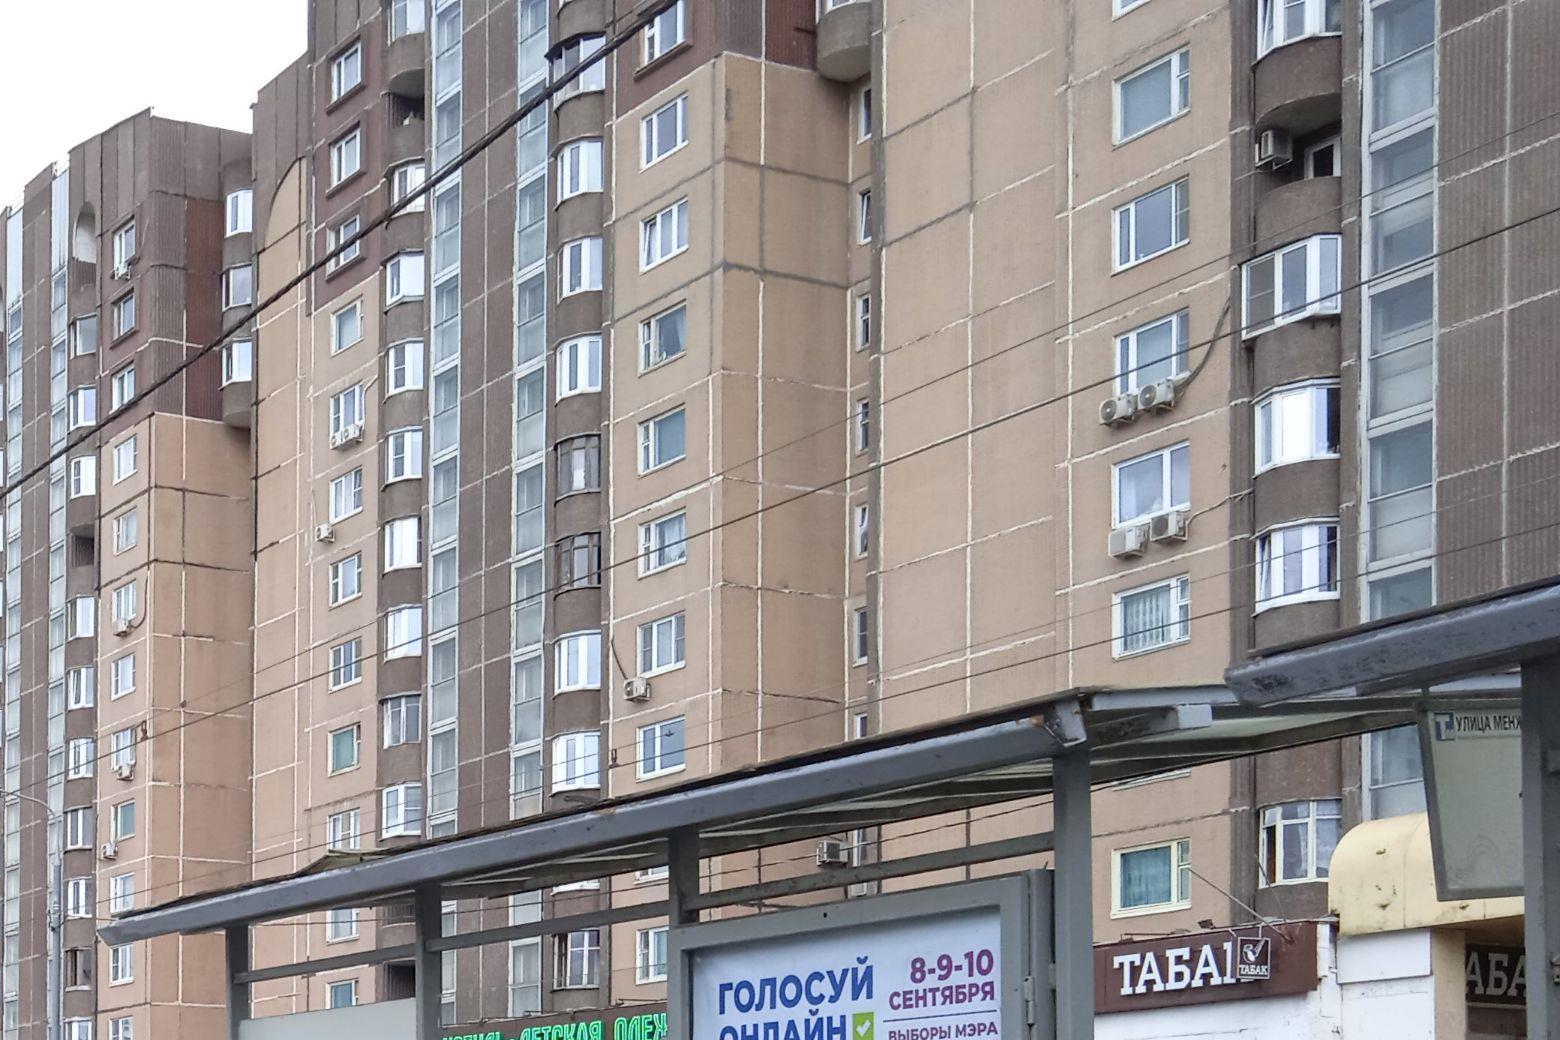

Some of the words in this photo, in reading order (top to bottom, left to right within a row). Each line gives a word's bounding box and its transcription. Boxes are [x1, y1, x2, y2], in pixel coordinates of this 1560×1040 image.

[1455, 715, 1491, 733] УЛИЦА
[910, 949, 994, 985] 8-9-10
[1239, 964, 1268, 975] ТАБАК
[719, 955, 874, 1015] ГОЛОСУЙ
[889, 981, 995, 1011] СЕНТЯБРЯ
[954, 1021, 998, 1039] МЭРА
